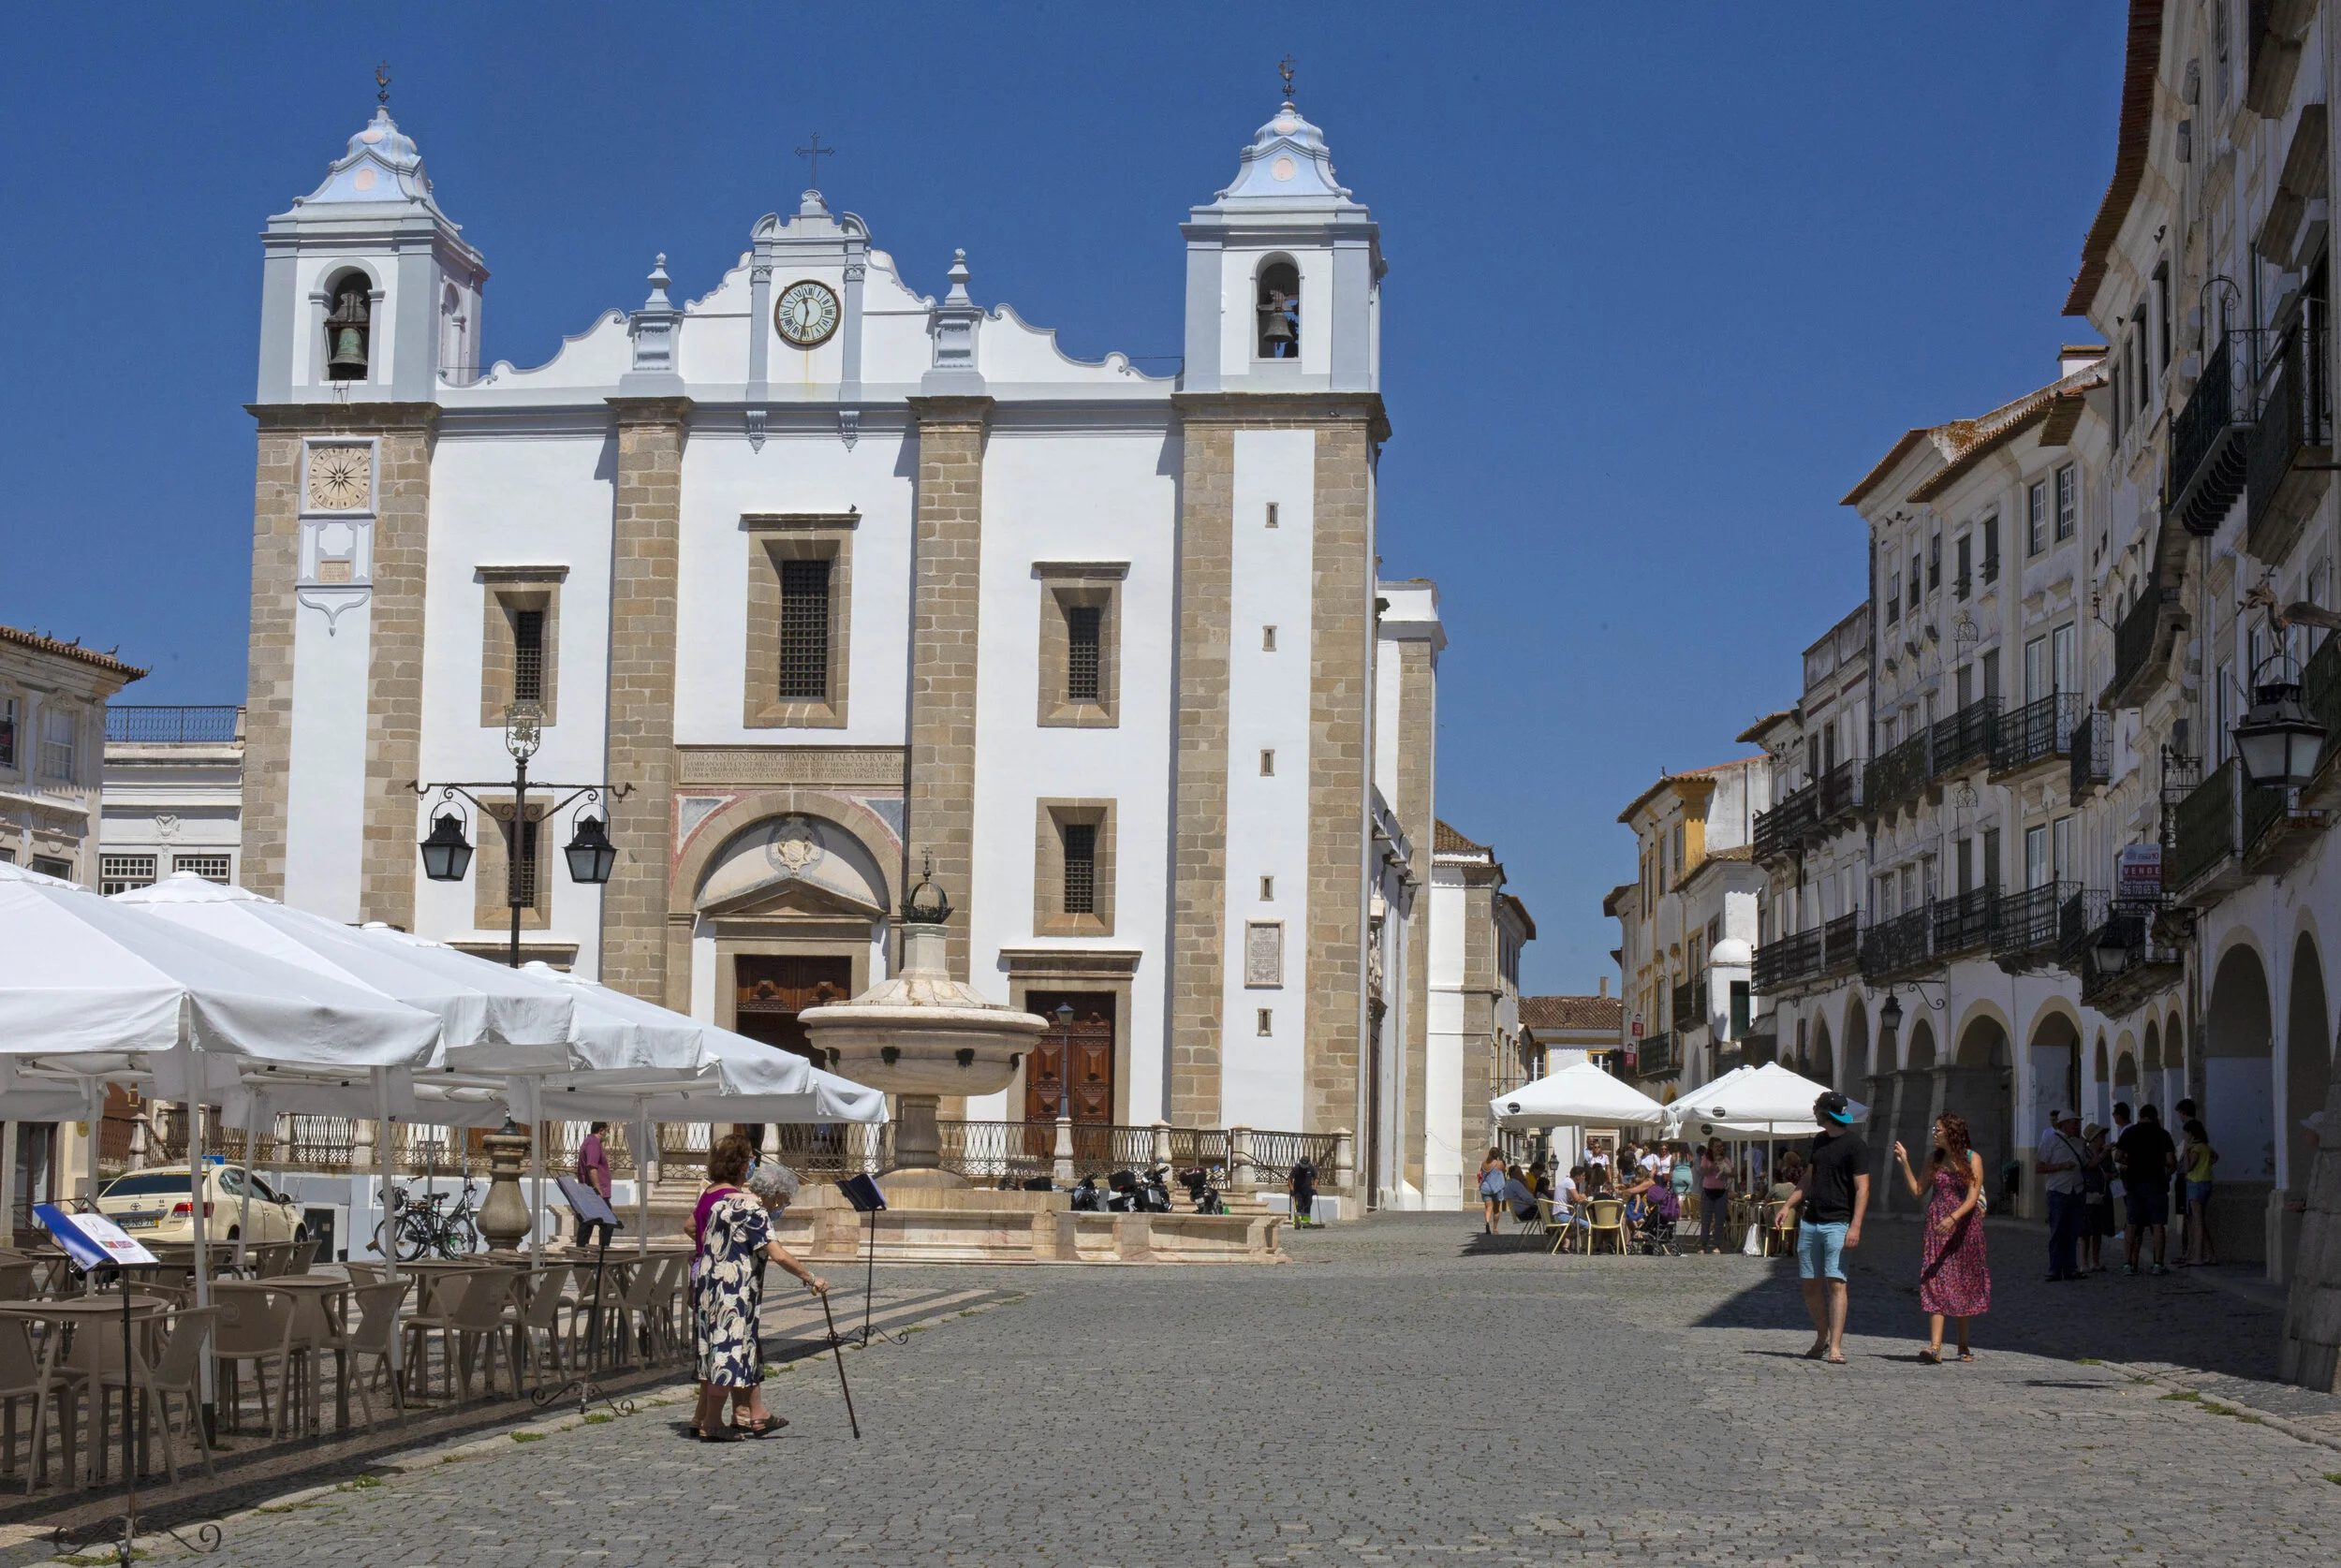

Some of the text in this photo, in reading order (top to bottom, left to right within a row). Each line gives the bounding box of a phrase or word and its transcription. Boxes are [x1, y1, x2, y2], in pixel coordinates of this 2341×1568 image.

[685, 753, 710, 761] DIVO
[713, 753, 758, 761] ANTONIO
[2124, 866, 2160, 874] VENDE
